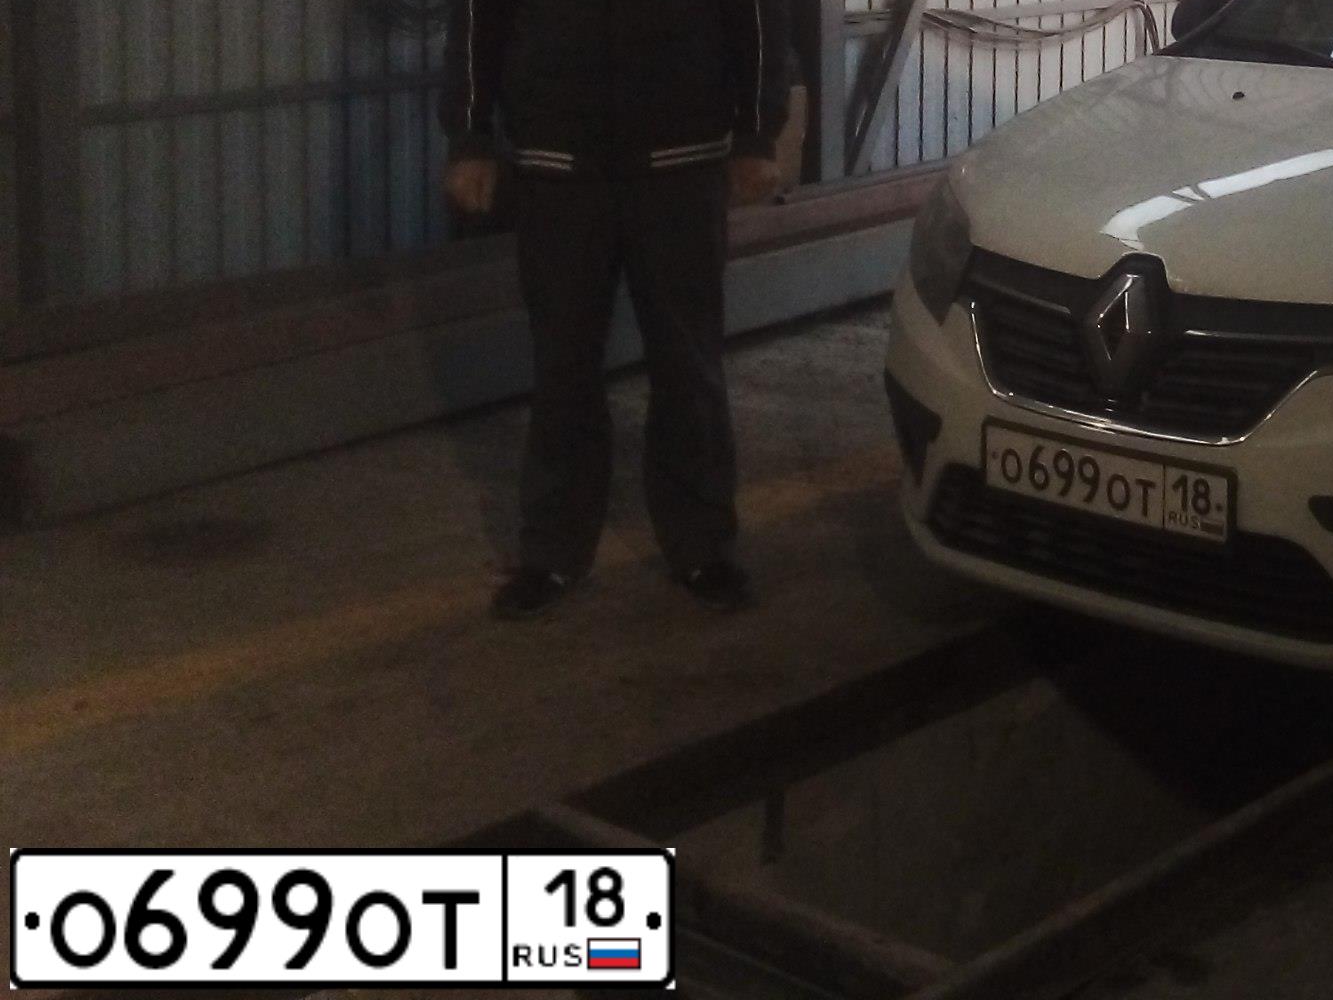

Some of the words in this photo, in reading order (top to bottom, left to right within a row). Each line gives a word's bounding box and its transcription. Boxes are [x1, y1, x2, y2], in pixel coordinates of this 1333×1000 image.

[1001, 446, 1155, 517] О699ОТ
[1173, 475, 1210, 515] 18
[1168, 511, 1200, 529] RUS
